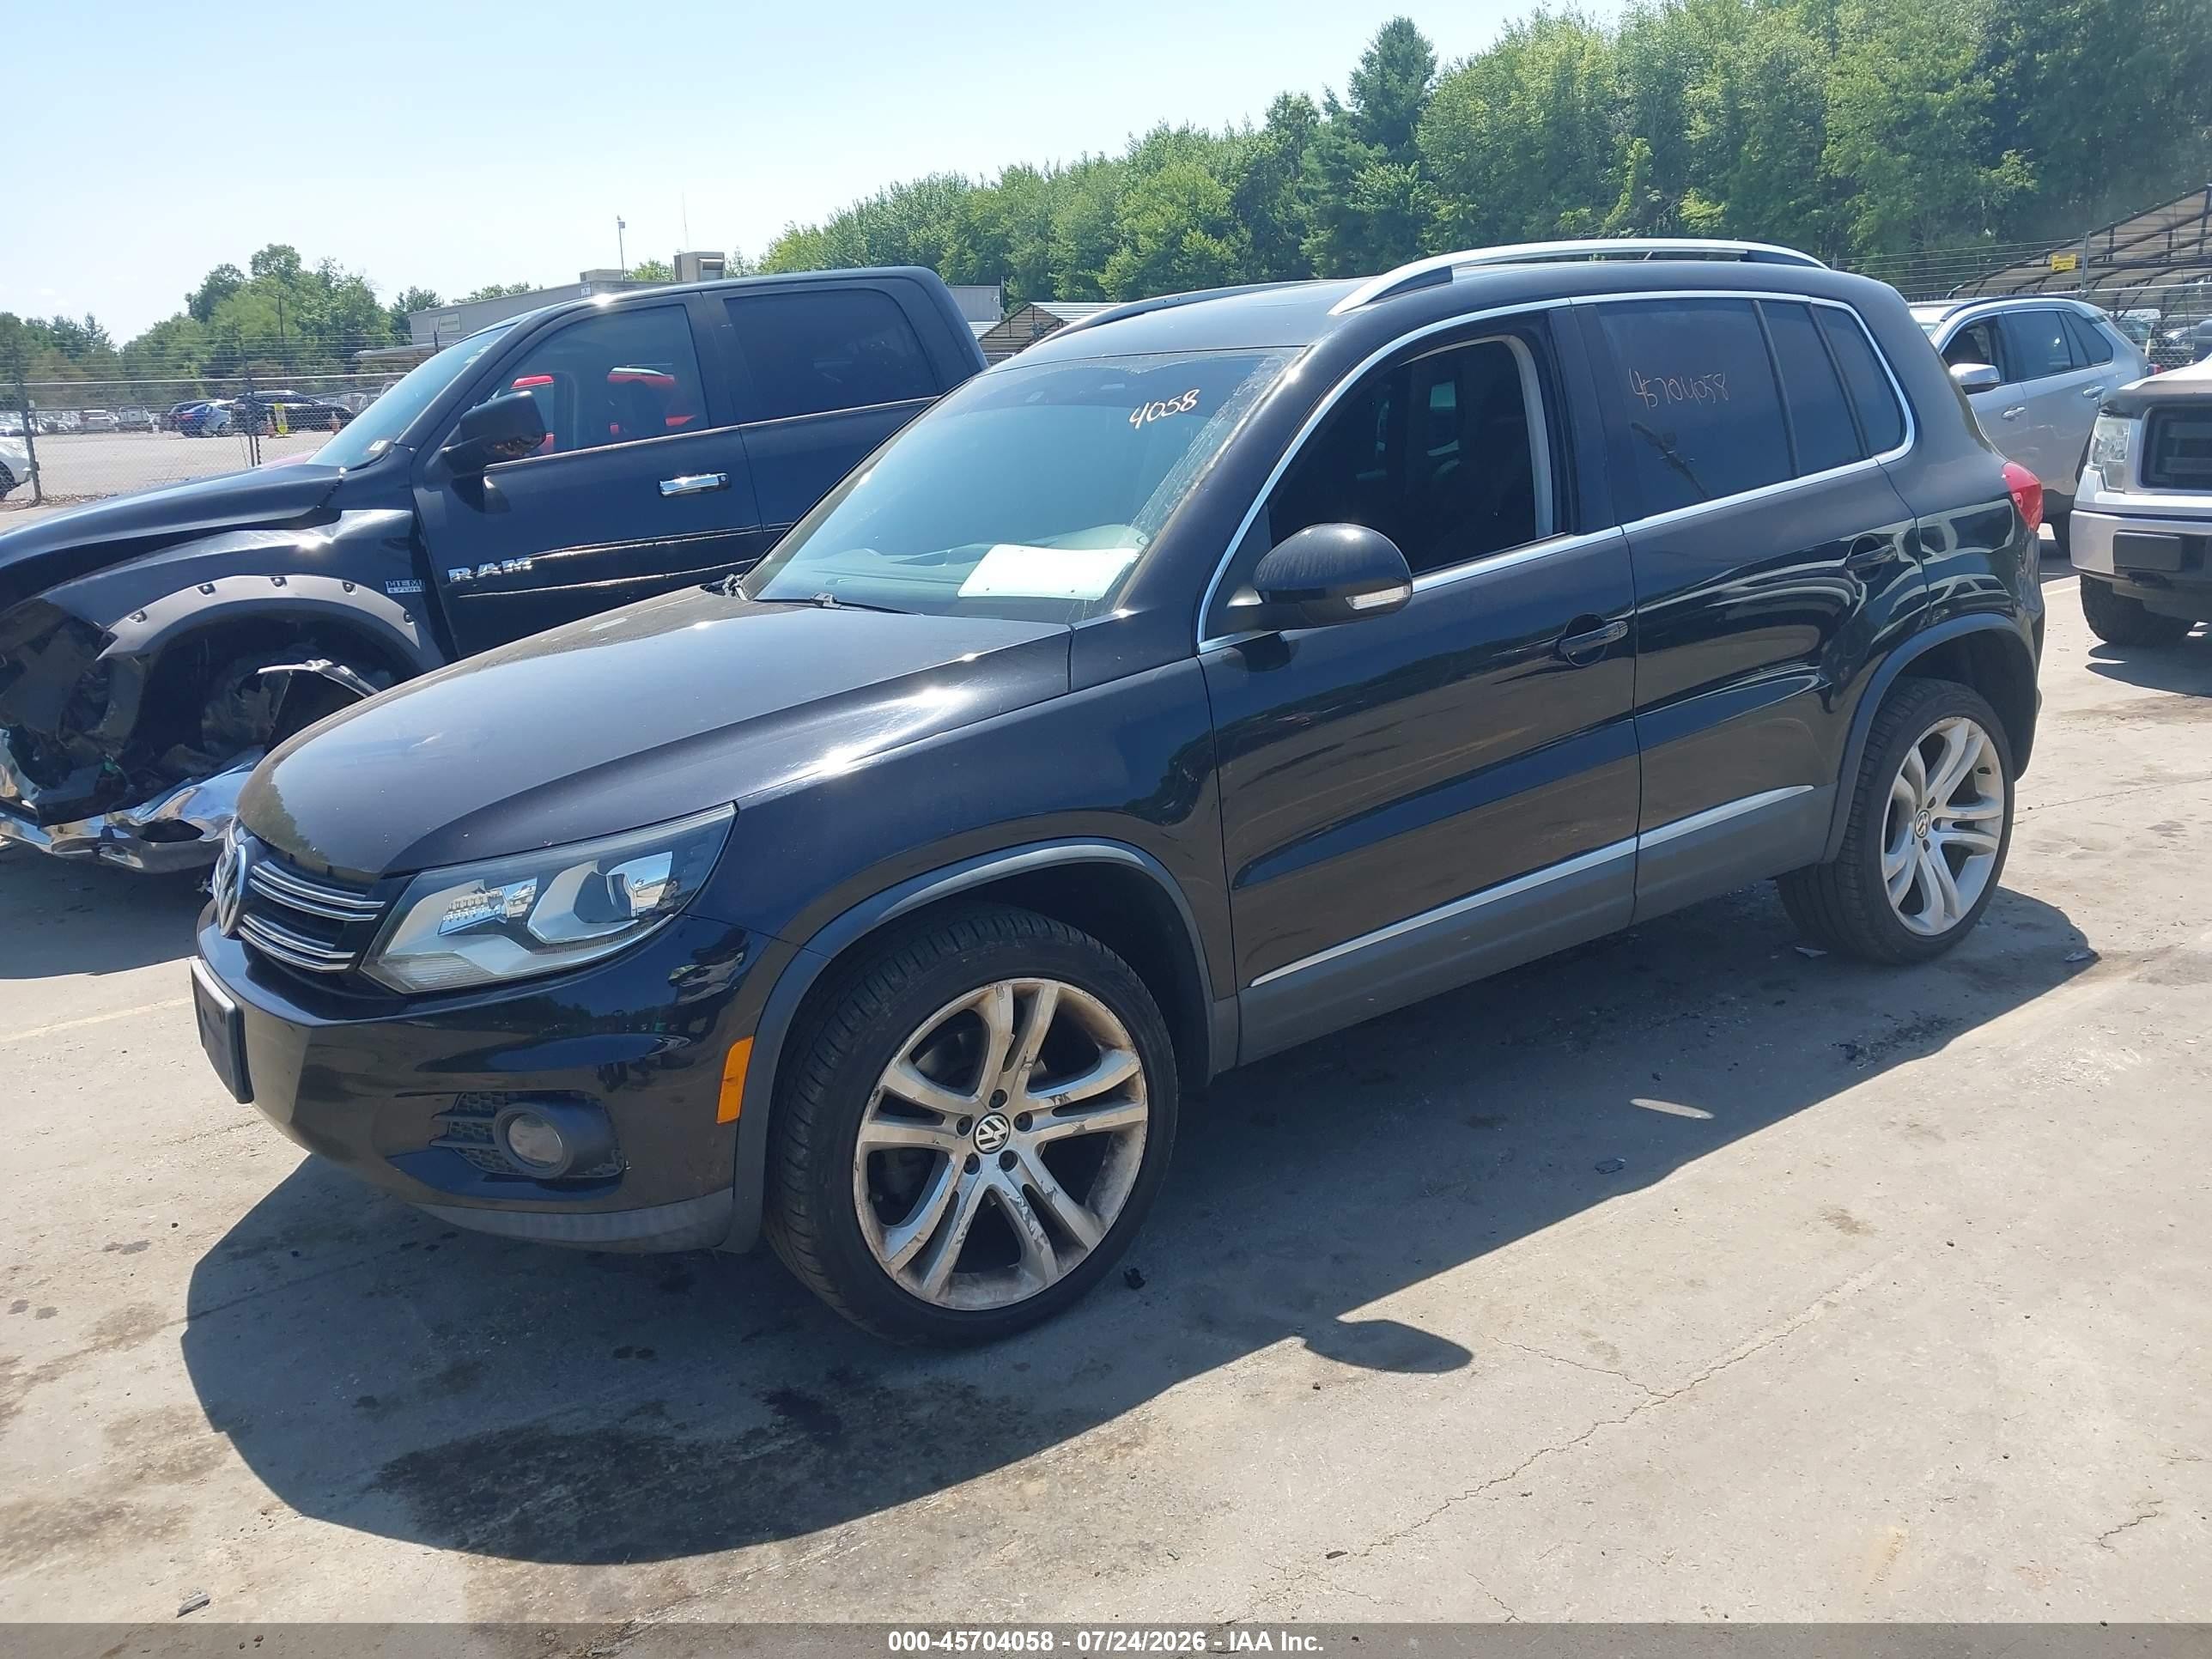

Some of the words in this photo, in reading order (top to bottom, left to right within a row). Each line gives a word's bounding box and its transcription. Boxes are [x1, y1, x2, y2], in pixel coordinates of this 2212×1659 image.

[1128, 388, 1200, 429] 4058
[1628, 367, 1729, 410] 45704058
[447, 556, 533, 583] RAM
